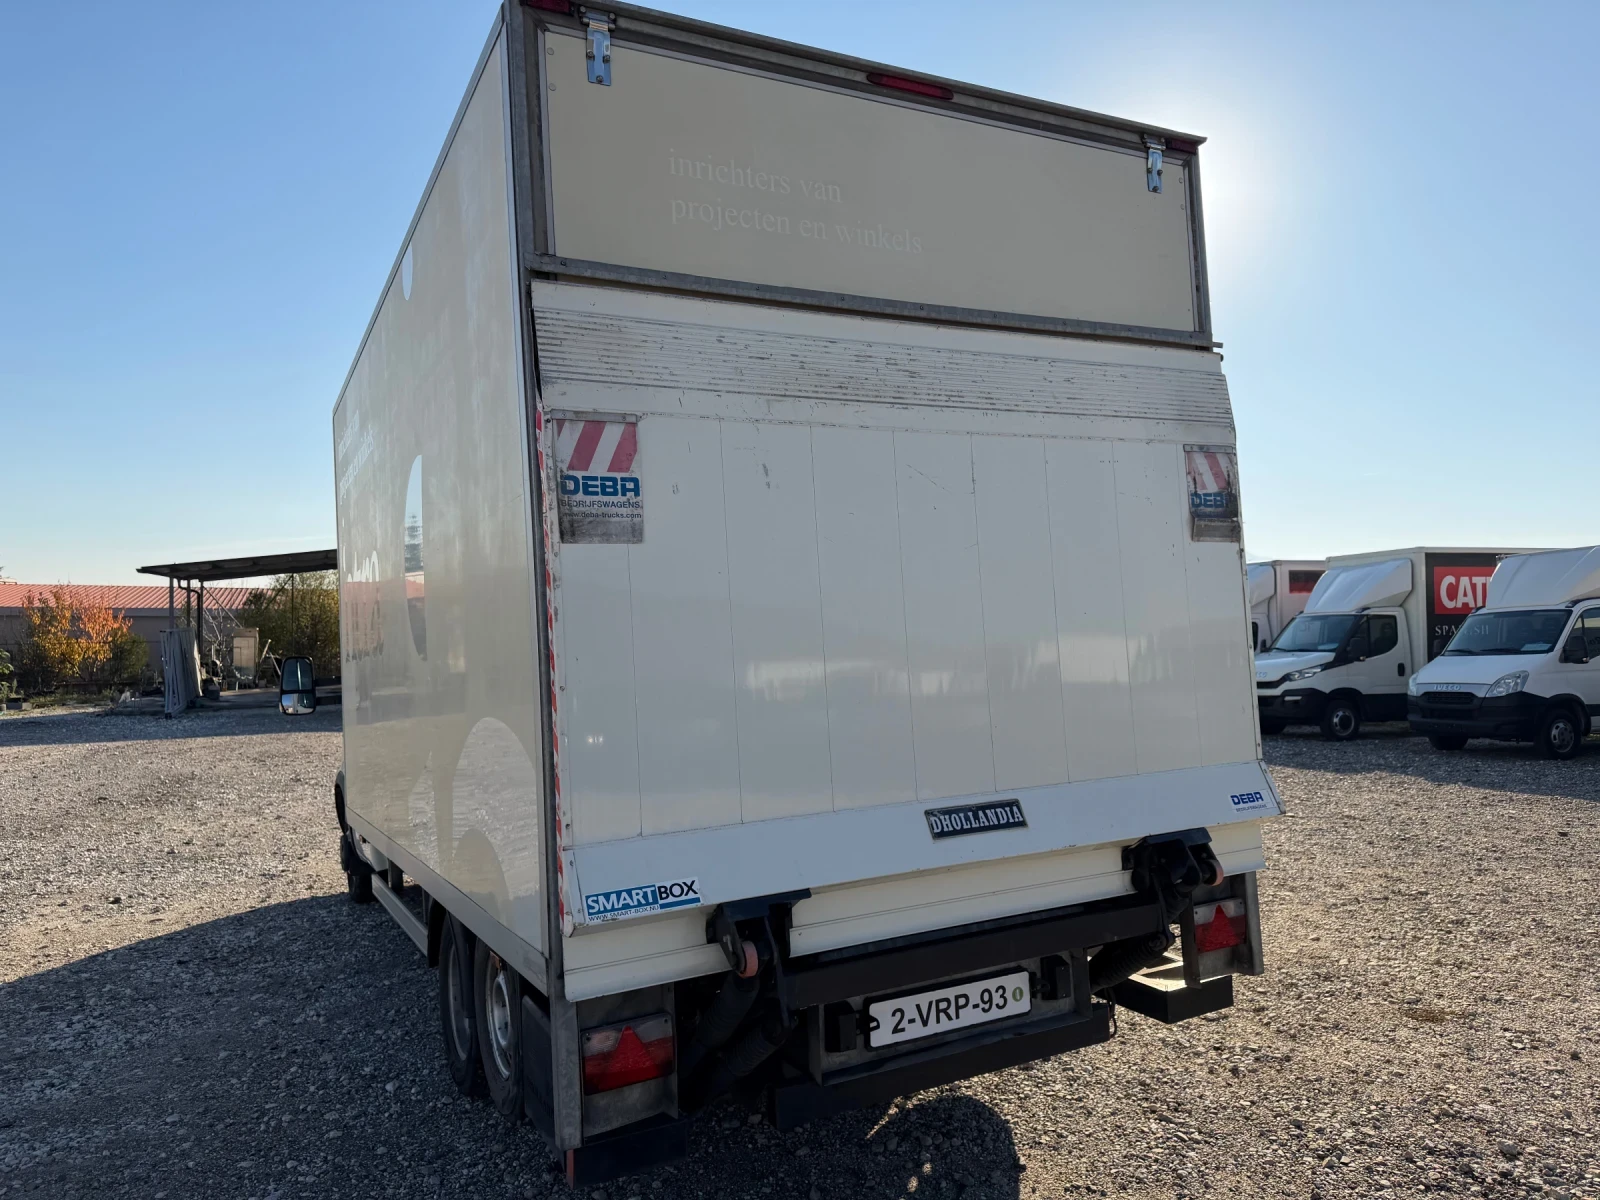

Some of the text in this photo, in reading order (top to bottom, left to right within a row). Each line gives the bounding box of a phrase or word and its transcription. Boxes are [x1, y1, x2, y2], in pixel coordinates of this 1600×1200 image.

[668, 148, 843, 203] inrichters van
[670, 197, 923, 254] projecten en winkels
[560, 475, 640, 497] DEBA
[561, 500, 641, 509] BEDRIJFSWAGENS
[1435, 625, 1489, 636] SPASH
[1230, 791, 1264, 805] DEBA
[930, 805, 1024, 833] DHOLLANDIA
[891, 985, 1008, 1035] 2-VRP-93
